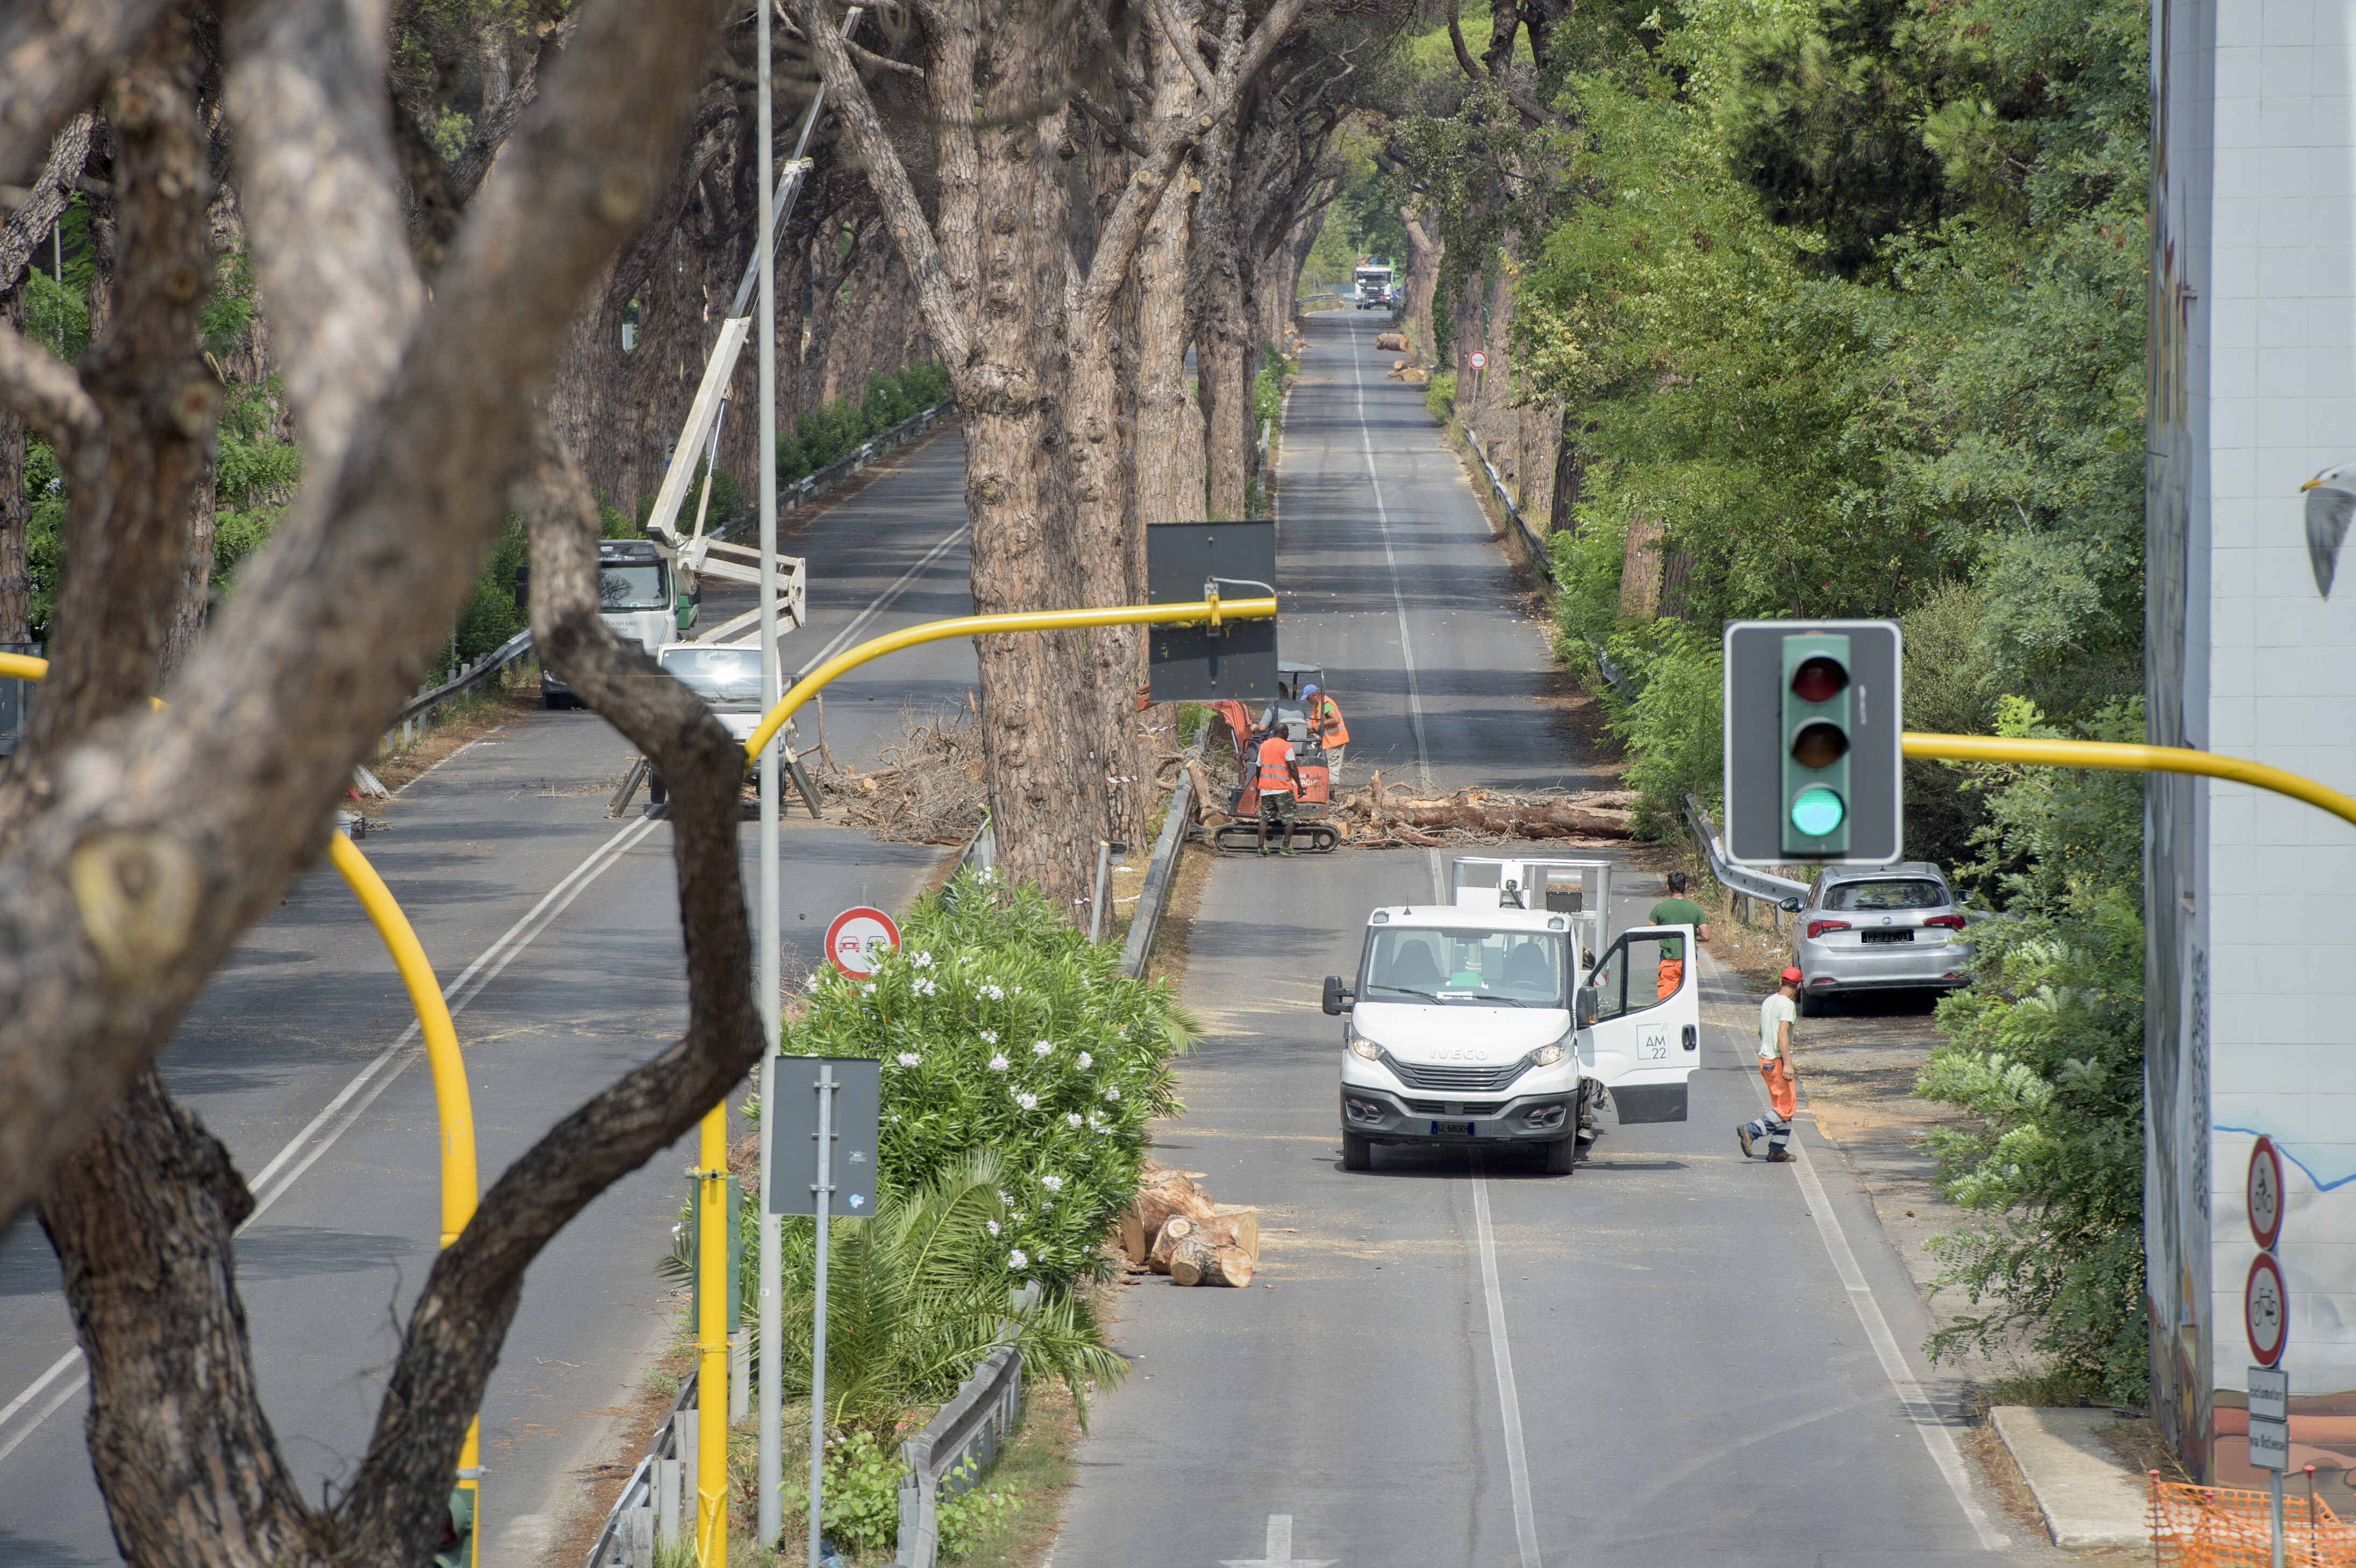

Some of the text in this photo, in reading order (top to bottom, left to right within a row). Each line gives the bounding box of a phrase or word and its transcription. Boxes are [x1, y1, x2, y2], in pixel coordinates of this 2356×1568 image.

[1646, 1035, 1665, 1047] AM
[1430, 1047, 1488, 1060] IVECO
[1652, 1047, 1667, 1059] 22
